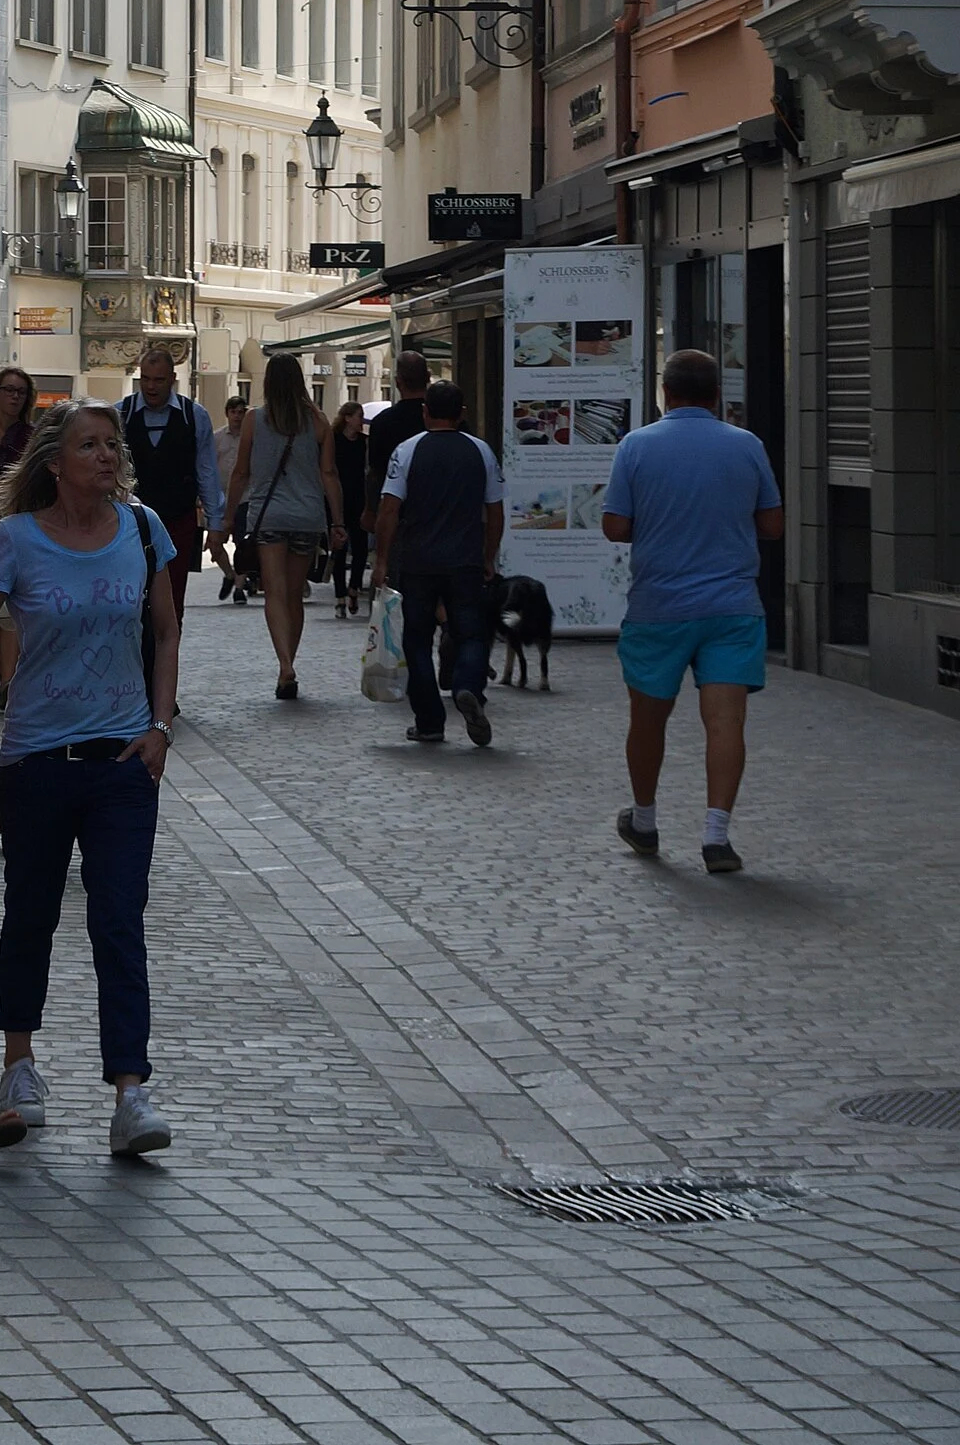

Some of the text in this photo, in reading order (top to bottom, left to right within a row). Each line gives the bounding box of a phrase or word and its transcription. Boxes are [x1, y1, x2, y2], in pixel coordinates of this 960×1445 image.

[434, 197, 516, 208] SCHLOSSBERG
[539, 265, 609, 277] SCHLOSSBERG
[104, 679, 141, 712] you
